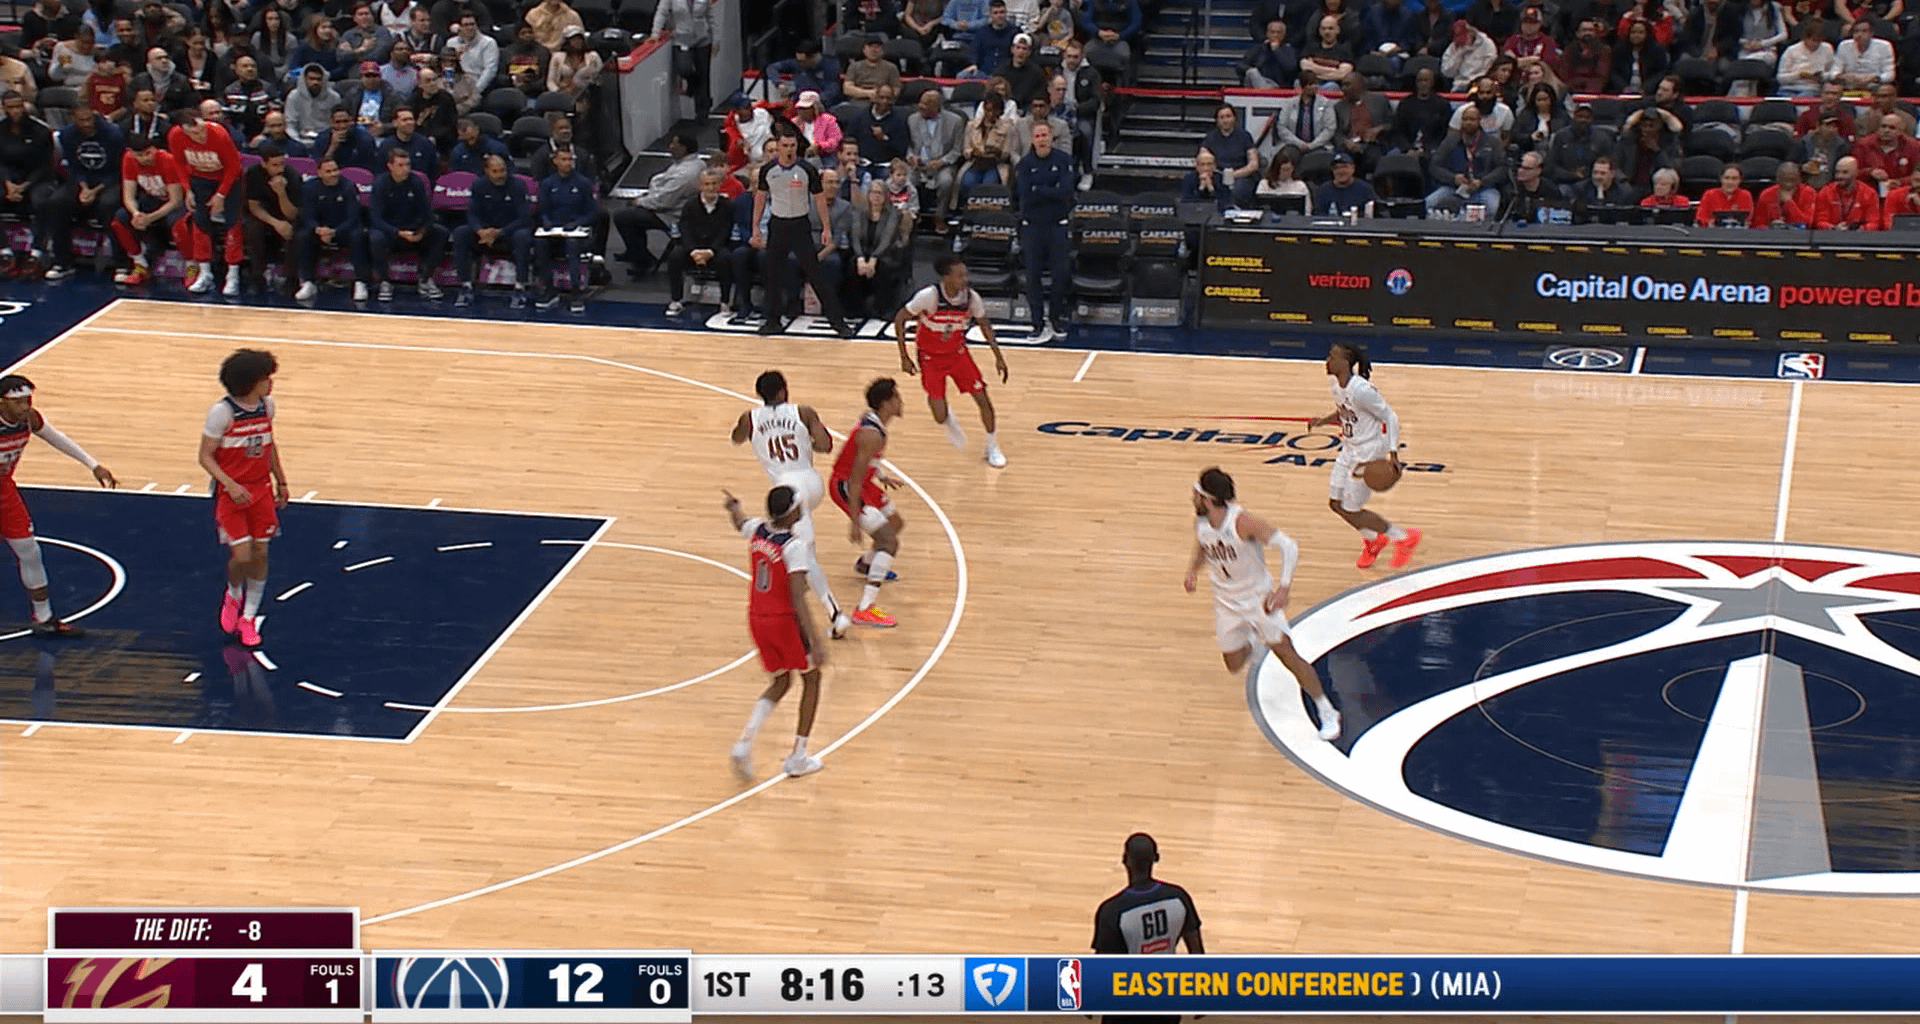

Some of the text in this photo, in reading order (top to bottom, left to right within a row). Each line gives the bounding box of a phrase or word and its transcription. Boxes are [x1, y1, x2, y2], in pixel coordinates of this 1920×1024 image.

[967, 197, 1010, 206] CAESARS
[1075, 204, 1119, 214] CAESARS
[1131, 205, 1175, 215] CAESARS
[972, 225, 1017, 236] CAESARS
[1082, 231, 1127, 240] CAESARS
[1140, 230, 1185, 240] CAESARS
[1308, 272, 1370, 288] verizon
[1537, 273, 1628, 302] Capital
[1632, 276, 1687, 300] One
[1690, 278, 1771, 303] Arena
[1779, 283, 1901, 308] powered
[1037, 421, 1287, 445] Capital
[768, 434, 799, 462] 45
[1262, 453, 1446, 472] Ara
[1142, 909, 1168, 940] 60
